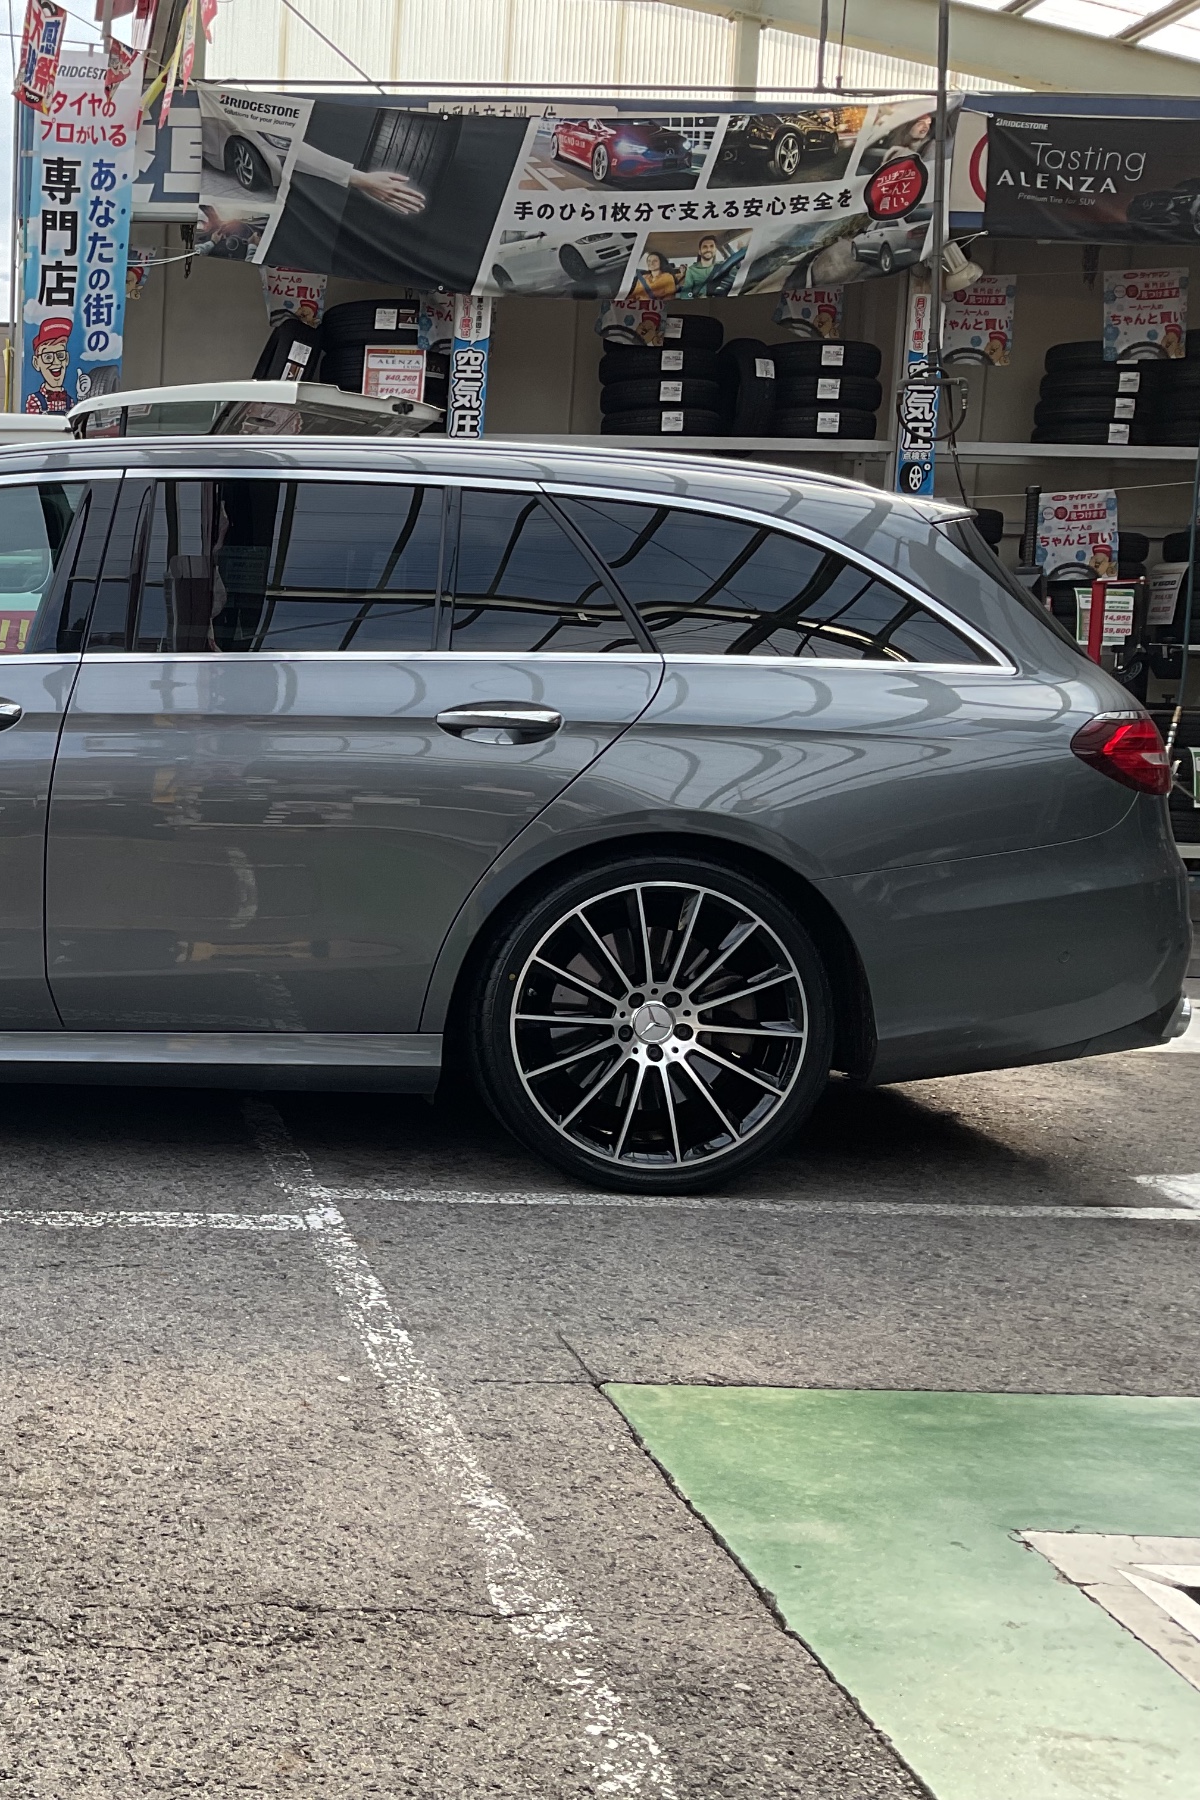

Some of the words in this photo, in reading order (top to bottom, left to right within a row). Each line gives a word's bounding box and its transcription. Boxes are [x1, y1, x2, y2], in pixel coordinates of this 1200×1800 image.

[58, 64, 107, 80] RIDGEST
[51, 90, 116, 118] タイヤの
[220, 94, 300, 119] BRIDGESTONE
[224, 108, 249, 119] Solutions
[250, 113, 259, 121] for
[273, 118, 296, 128] journey
[996, 118, 1049, 131] BRIDGESTONE
[40, 118, 127, 147] プロがいる
[1030, 141, 1147, 182] Tasting
[996, 169, 1118, 194] ALENZA
[513, 188, 853, 223] 手のひら1枚分で支える安心安全を
[1078, 197, 1096, 206] SUV
[38, 156, 82, 308] 専門店
[83, 158, 116, 353] あなたの街の
[377, 358, 421, 366] ALENZA
[451, 349, 485, 438] 空気圧
